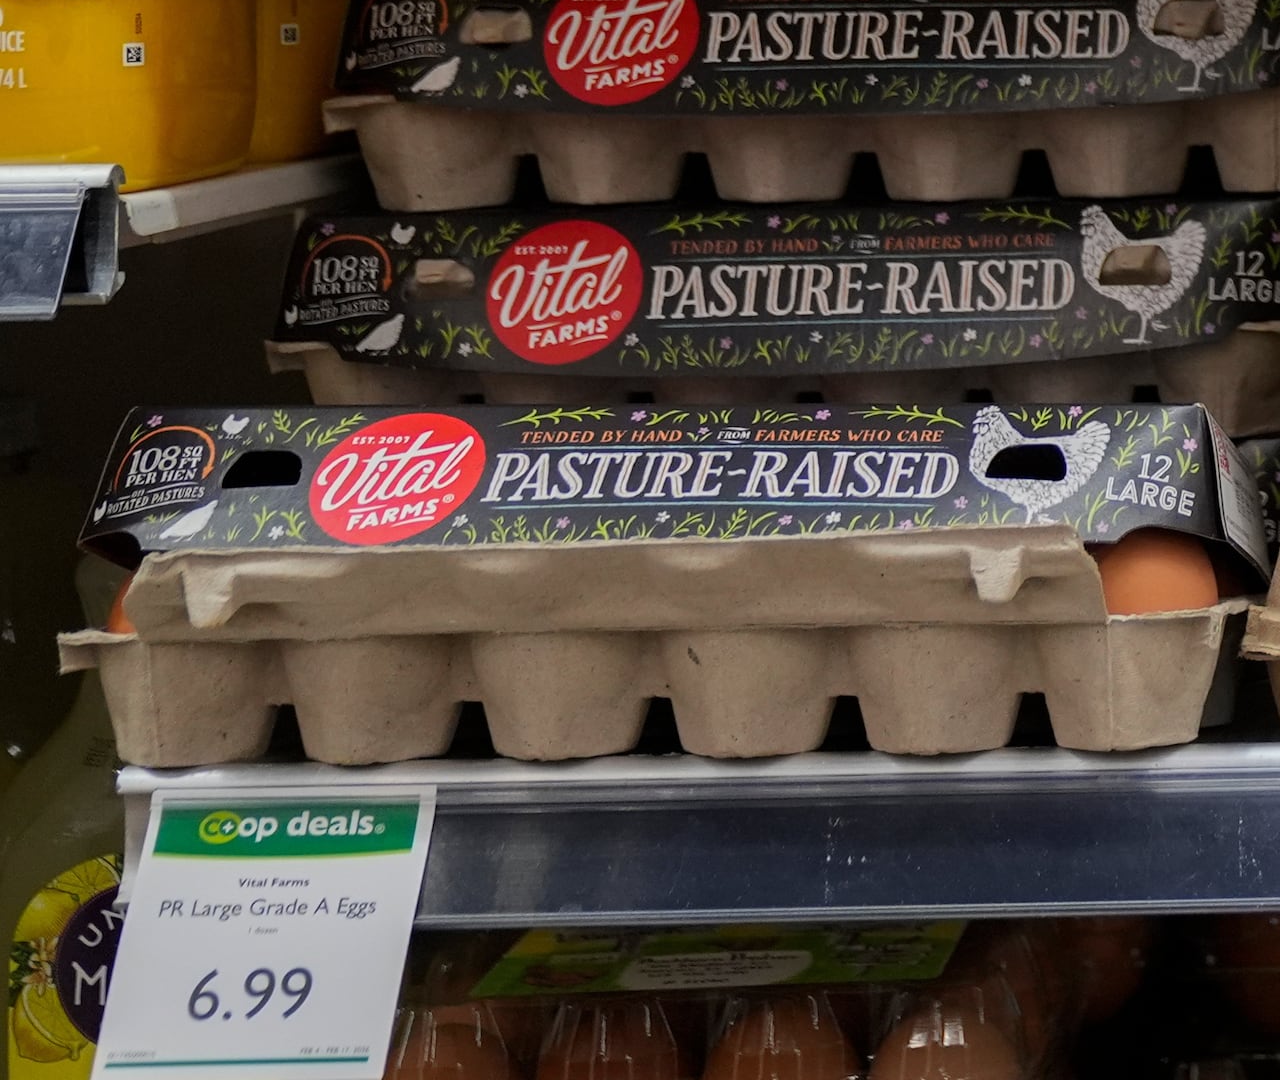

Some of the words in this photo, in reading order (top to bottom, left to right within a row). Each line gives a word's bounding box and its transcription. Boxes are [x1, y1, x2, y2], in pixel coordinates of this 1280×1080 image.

[703, 9, 1130, 64] PASTURE-RAISED
[584, 59, 666, 91] FARMS
[1235, 251, 1265, 277] 12
[490, 238, 629, 327] Vital
[645, 258, 1075, 320] PASTURE-RAISED
[528, 315, 609, 349] FARMS
[352, 436, 377, 445] EST.
[378, 434, 410, 445] 2007
[521, 430, 594, 444] TENDED
[601, 430, 626, 443] BY
[629, 429, 682, 443] HAND
[717, 429, 751, 441] FROM
[755, 428, 841, 442] FARMERS
[847, 428, 891, 442] WHO
[896, 428, 944, 442] CARE
[131, 445, 179, 472] 108
[180, 458, 203, 472] FT
[317, 430, 474, 512] Vital
[1137, 455, 1170, 483] 12
[126, 472, 157, 487] PER
[160, 469, 197, 485] HEN
[479, 449, 960, 503] PASTURE-RAISED
[106, 495, 150, 516] ROTATED
[150, 486, 205, 507] PASTURES
[1105, 477, 1196, 515] LARGE
[346, 499, 439, 531] FARMS
[239, 877, 267, 888] Vital
[271, 877, 309, 888] Farms
[159, 900, 183, 918] PR
[191, 899, 242, 921] Large
[250, 897, 308, 916] Grade
[314, 897, 329, 915] A
[337, 897, 377, 919] Eggs
[187, 967, 313, 1021] 6.99
